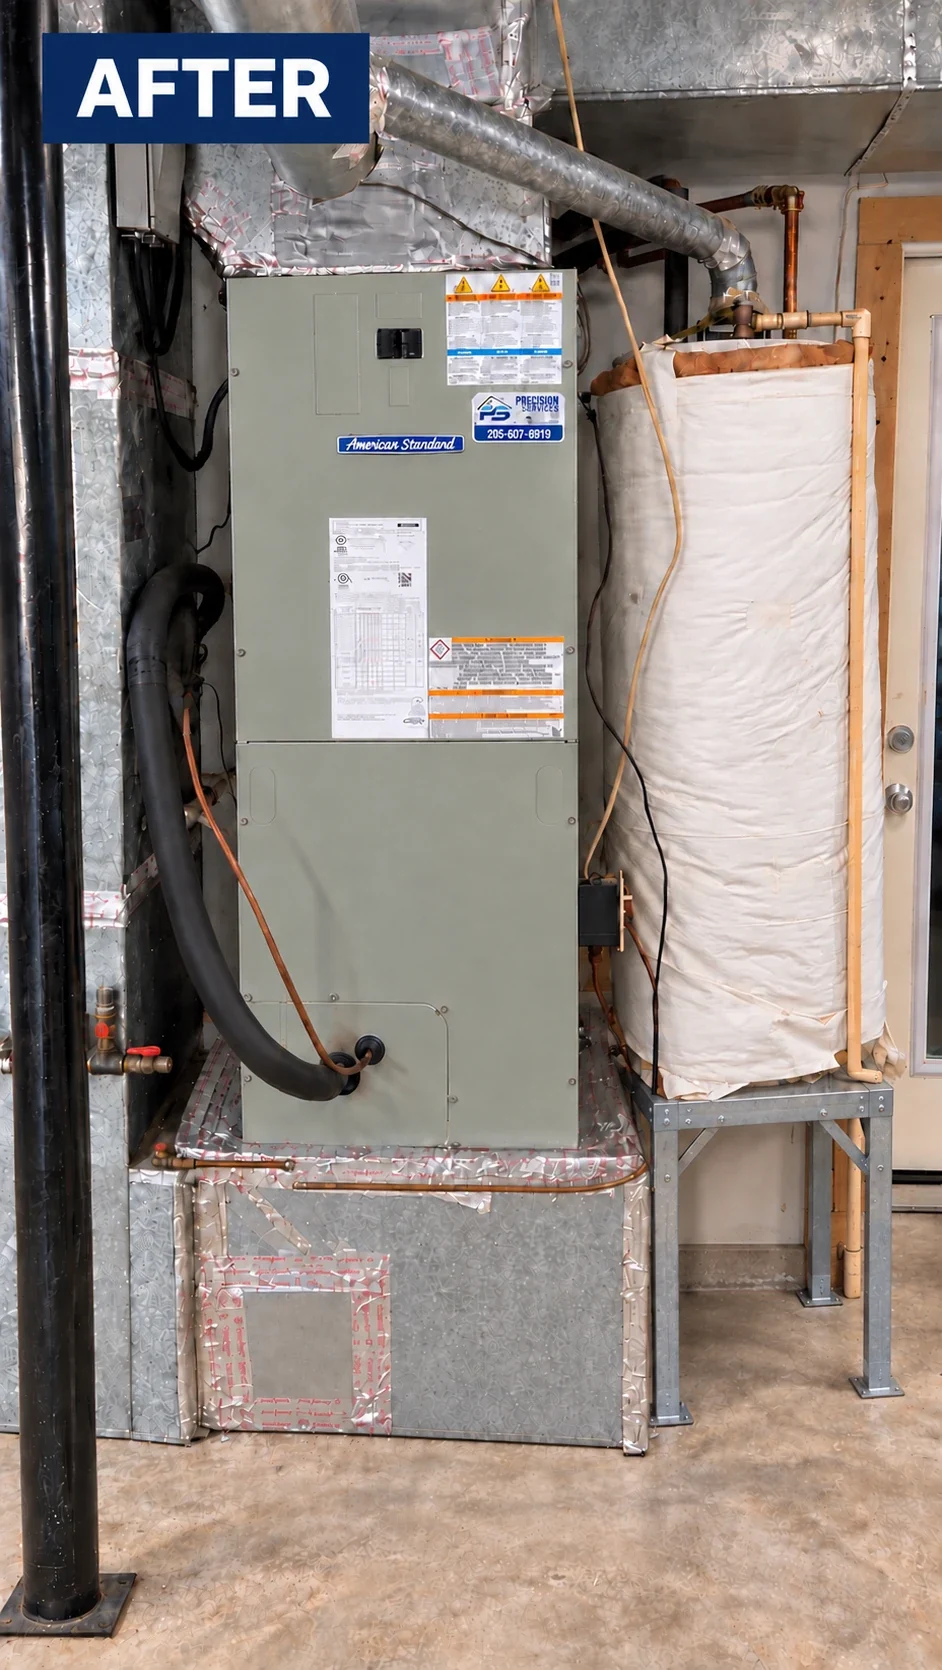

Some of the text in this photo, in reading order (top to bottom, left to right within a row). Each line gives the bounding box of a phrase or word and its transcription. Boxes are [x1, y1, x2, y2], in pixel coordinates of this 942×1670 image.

[515, 395, 559, 406] PRECISION
[346, 436, 456, 451] American Standard
